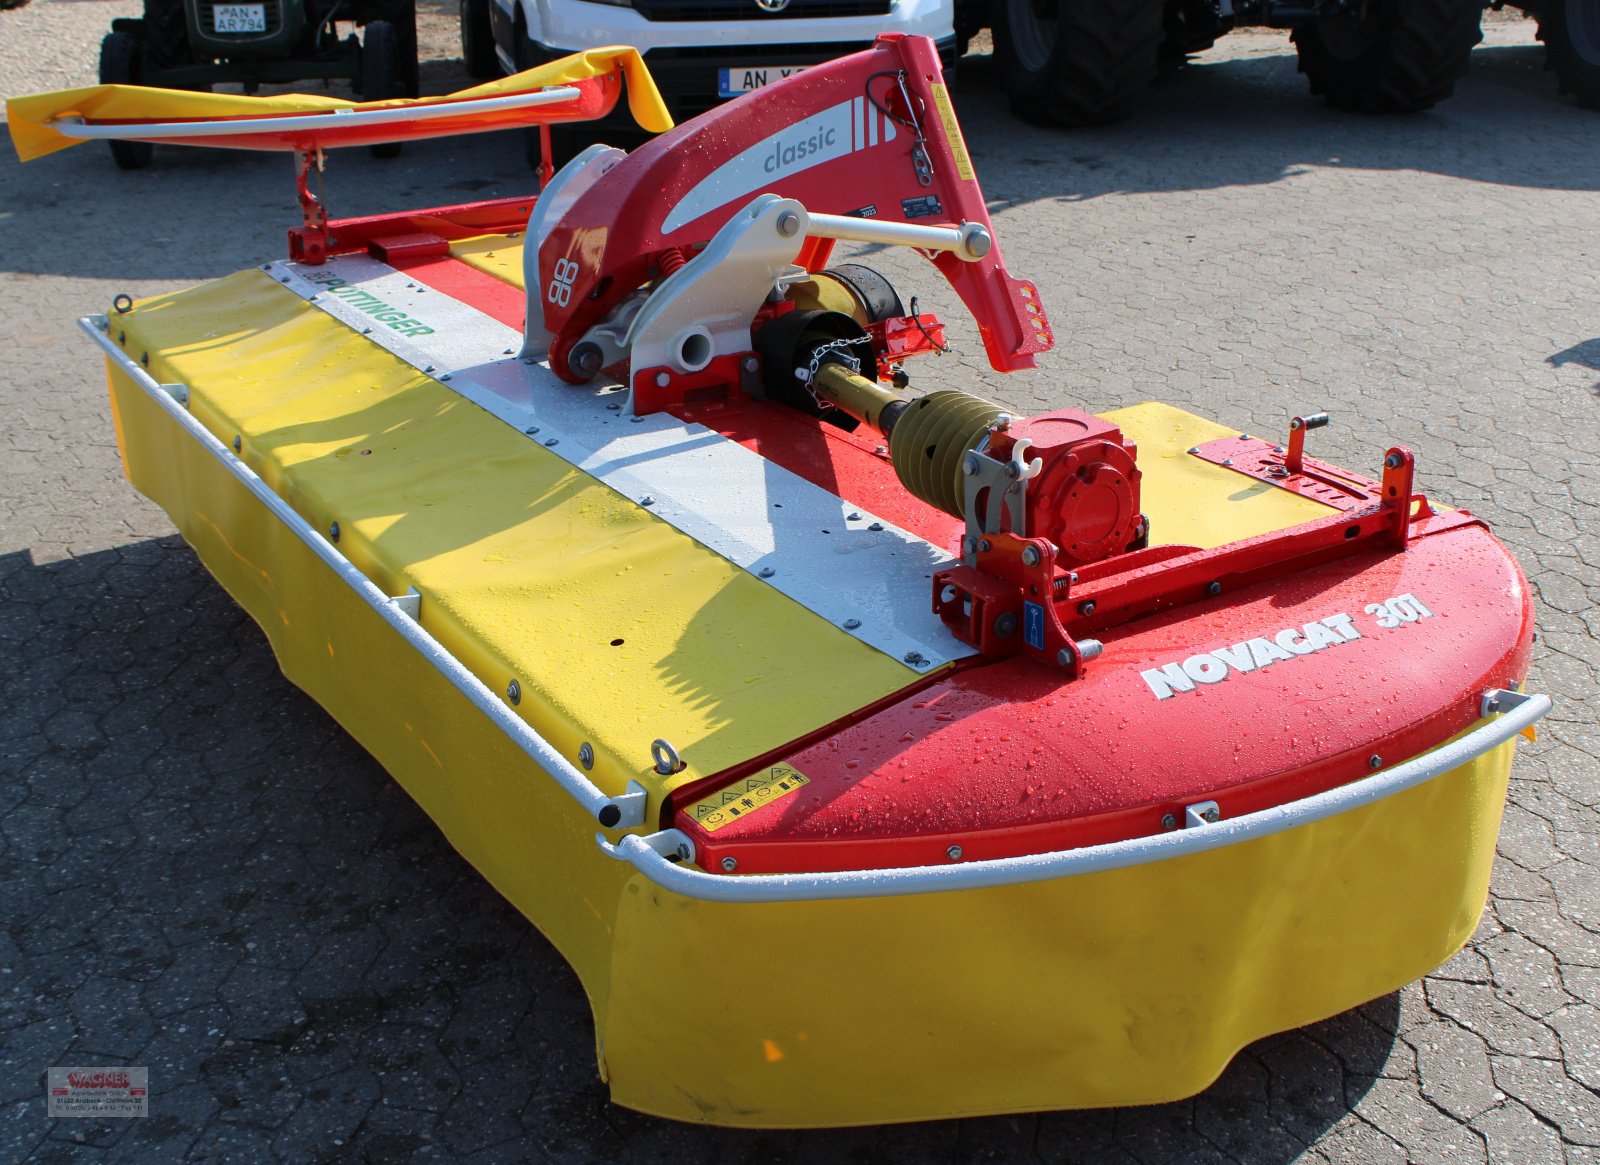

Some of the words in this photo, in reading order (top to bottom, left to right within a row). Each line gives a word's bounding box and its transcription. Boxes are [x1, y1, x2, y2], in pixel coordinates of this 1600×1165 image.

[230, 7, 249, 18] AN
[743, 70, 767, 89] AN
[764, 126, 835, 173] classic
[862, 208, 877, 218] 2023
[1139, 612, 1364, 701] NOVACAT
[1364, 592, 1435, 629] 301
